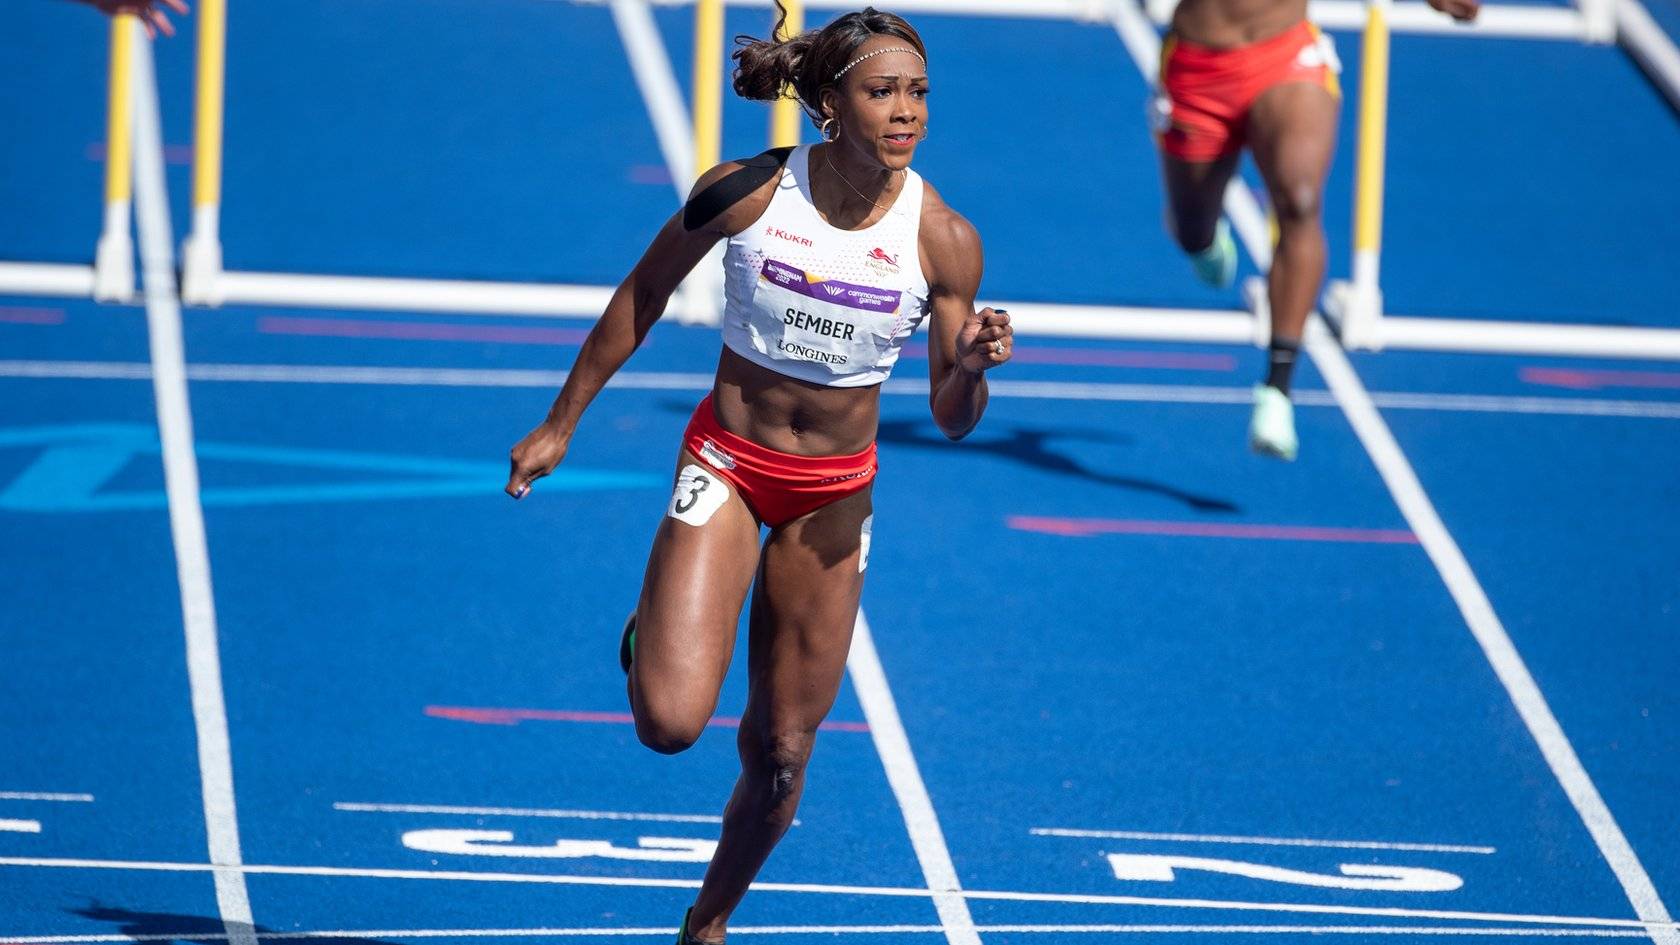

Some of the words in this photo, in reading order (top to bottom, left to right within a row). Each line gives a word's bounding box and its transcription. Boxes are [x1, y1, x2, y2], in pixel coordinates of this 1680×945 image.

[775, 229, 813, 248] KUKRI
[783, 307, 855, 341] SEMBER
[776, 338, 848, 365] LONGINES
[675, 475, 711, 514] 3
[1107, 853, 1464, 893] 2
